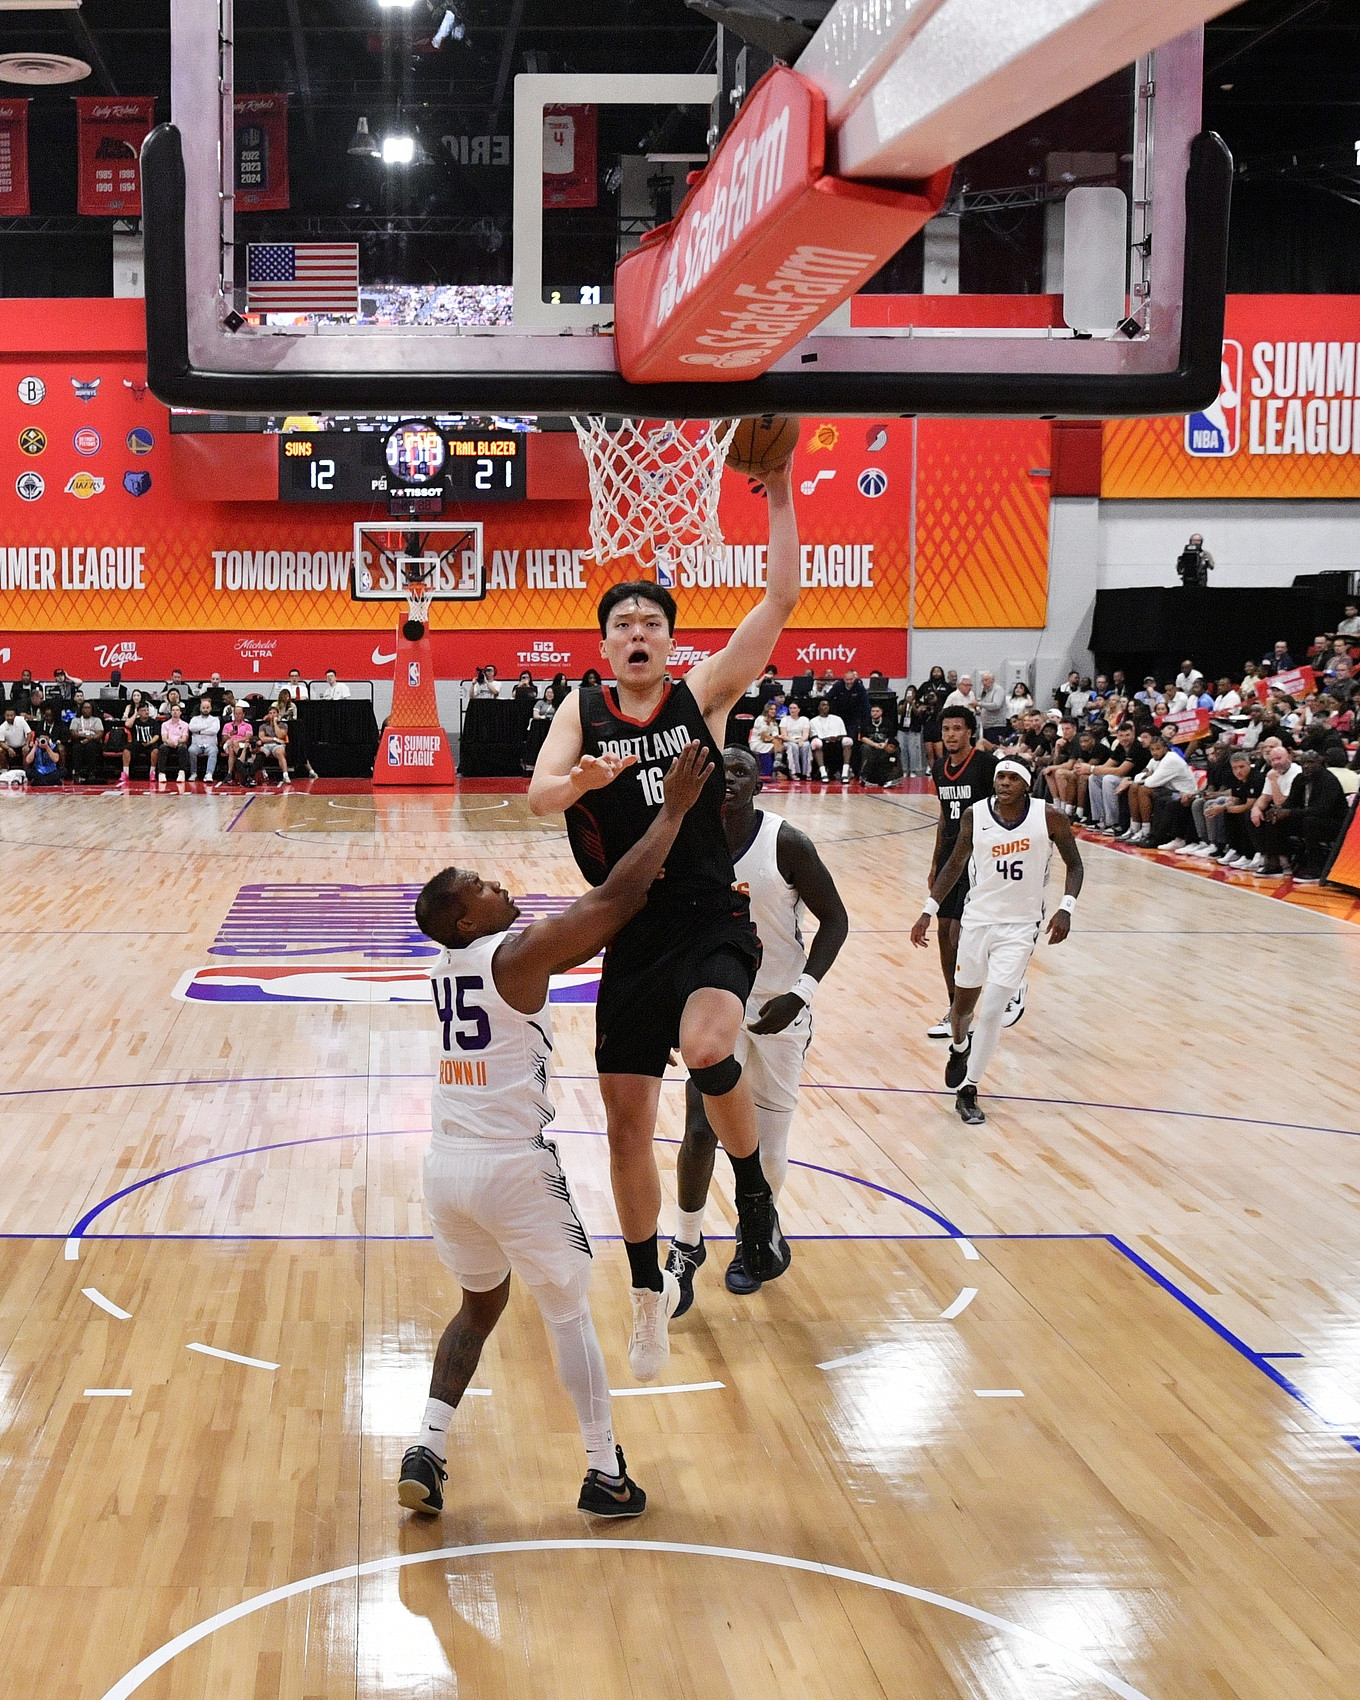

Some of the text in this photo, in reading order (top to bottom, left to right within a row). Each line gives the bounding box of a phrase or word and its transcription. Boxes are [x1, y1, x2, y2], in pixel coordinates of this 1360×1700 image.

[554, 131, 565, 147] 4
[242, 151, 260, 160] 2022
[241, 163, 261, 172] 2023
[241, 174, 261, 183] 2024
[551, 285, 600, 304] 2 21
[285, 441, 312, 457] SUNS
[448, 441, 516, 456] TRAIL BLAZER
[1192, 430, 1220, 449] NBA
[310, 459, 336, 490] 12
[475, 459, 513, 490] 21
[404, 488, 443, 497] TISSOT
[62, 546, 146, 590] LEAGUE
[461, 550, 519, 590] PAY
[526, 549, 587, 589] HERE
[680, 544, 875, 588] SUMME EAGUE
[94, 643, 144, 669] Vegas
[241, 650, 273, 658] ULTRA
[517, 652, 571, 662] TISSOT
[797, 643, 857, 663] xfinity
[404, 736, 441, 751] SUMMER
[598, 724, 692, 764] PORTLAND
[404, 752, 435, 766] LEAGUE
[636, 766, 665, 806] 16
[938, 785, 972, 800] PORTLAND
[950, 801, 961, 819] 26
[991, 838, 1030, 858] SUNS
[996, 860, 1024, 881] 46
[431, 975, 492, 1051] 45
[439, 1060, 474, 1086] ROWN
